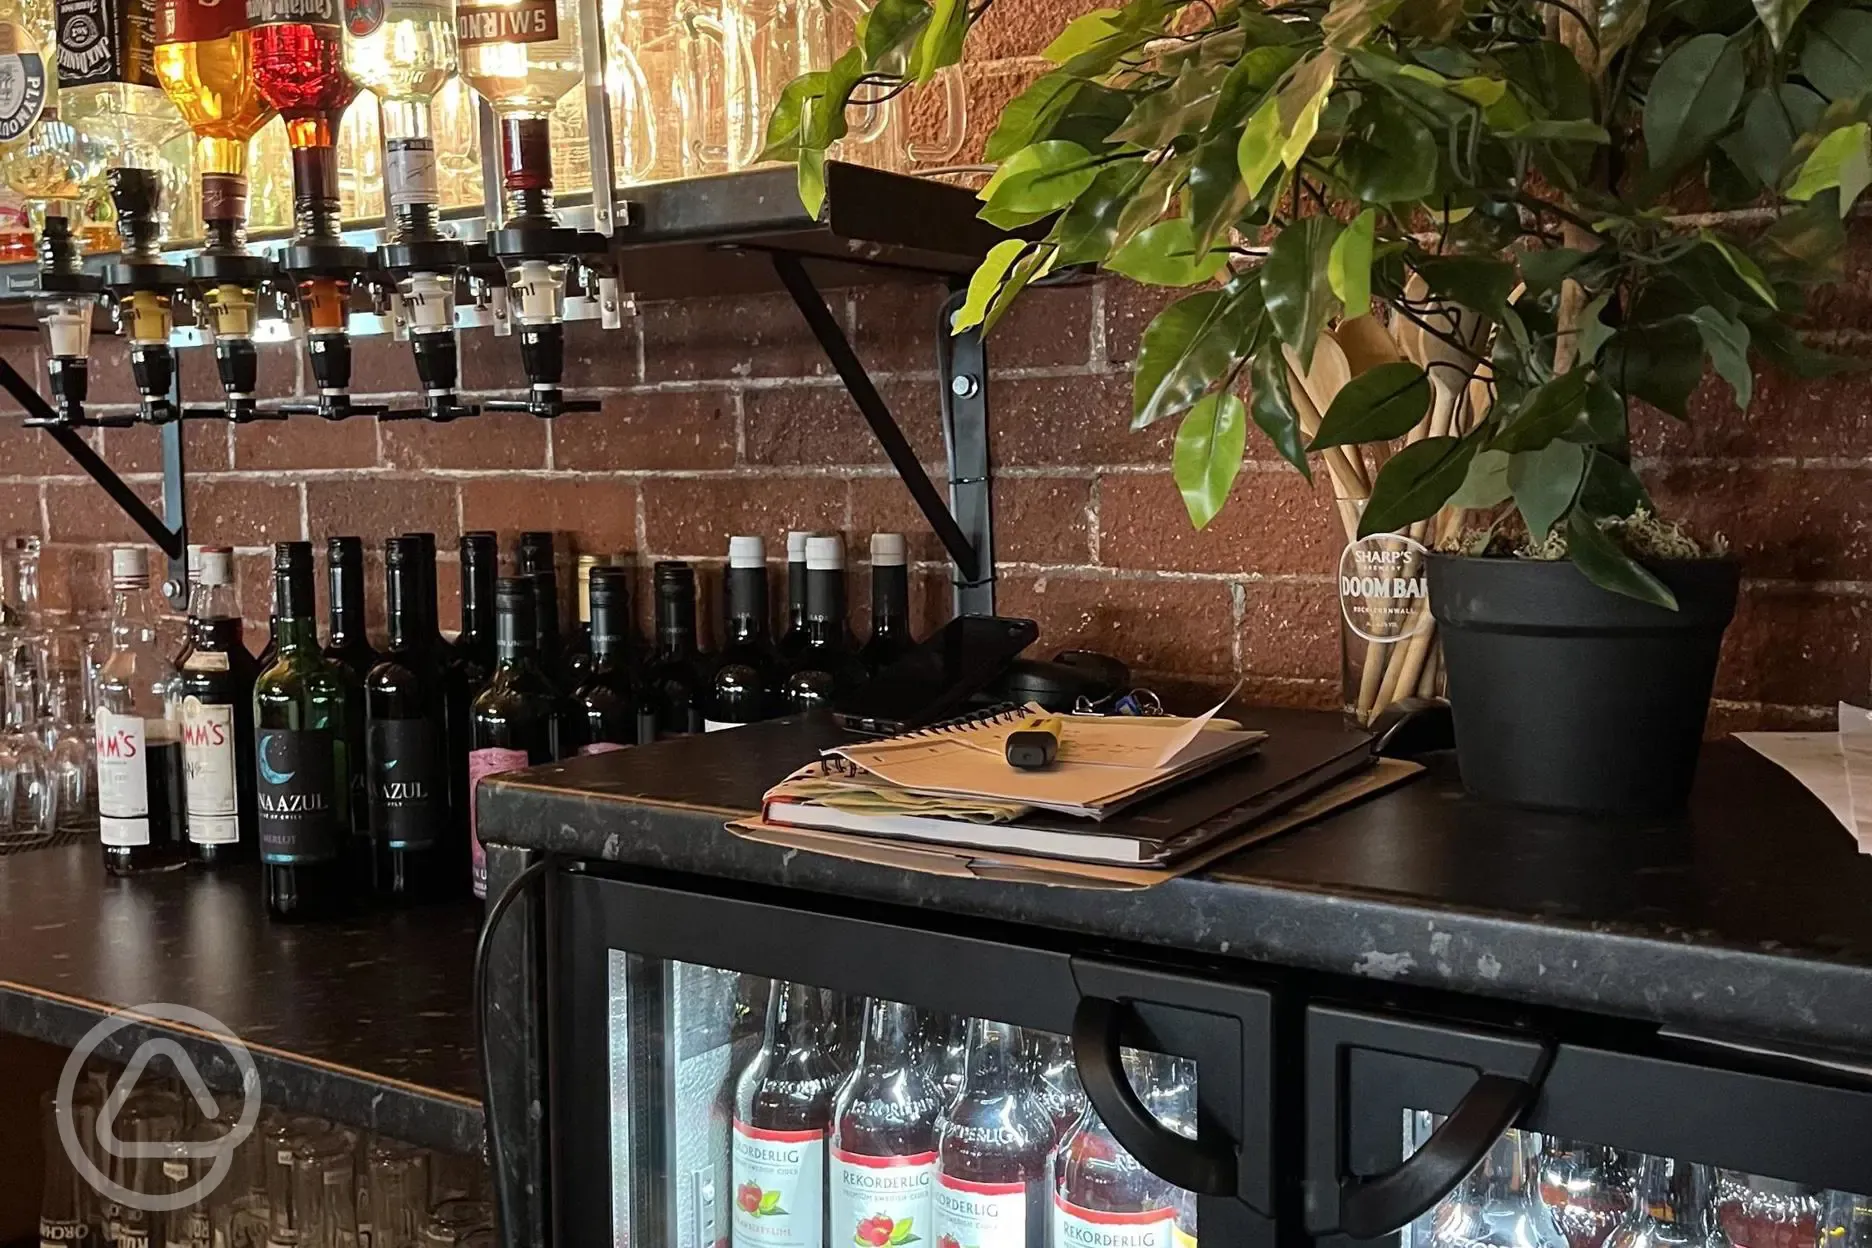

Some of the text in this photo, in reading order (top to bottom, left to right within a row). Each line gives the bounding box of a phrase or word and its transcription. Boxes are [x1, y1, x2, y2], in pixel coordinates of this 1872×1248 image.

[1355, 550, 1413, 564] SHARP'S
[1342, 575, 1390, 598] DOOM
[276, 792, 329, 812] AZUL
[843, 1170, 930, 1190] REKORDERLIG
[1063, 1220, 1155, 1248] REKORDERLIG
